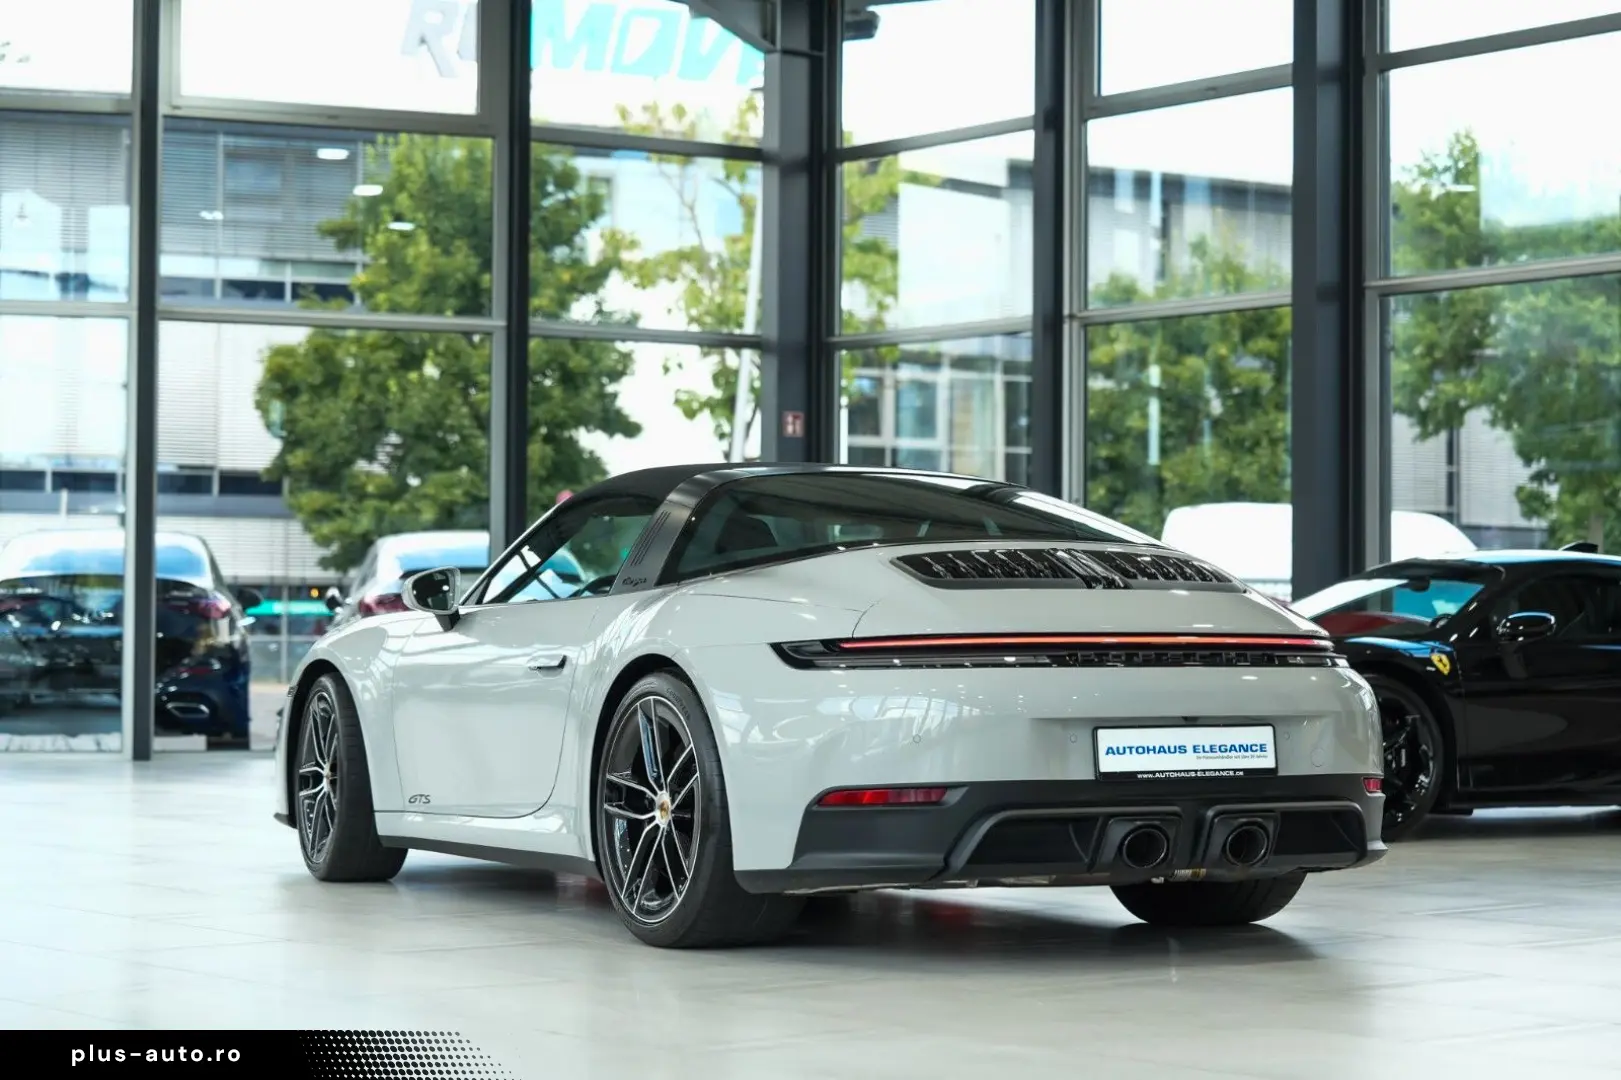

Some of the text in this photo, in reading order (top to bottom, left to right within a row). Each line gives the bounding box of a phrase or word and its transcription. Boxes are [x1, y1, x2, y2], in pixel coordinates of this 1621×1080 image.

[1105, 743, 1268, 756] AUTOHAUS ELEGANCE
[408, 793, 431, 804] GTS
